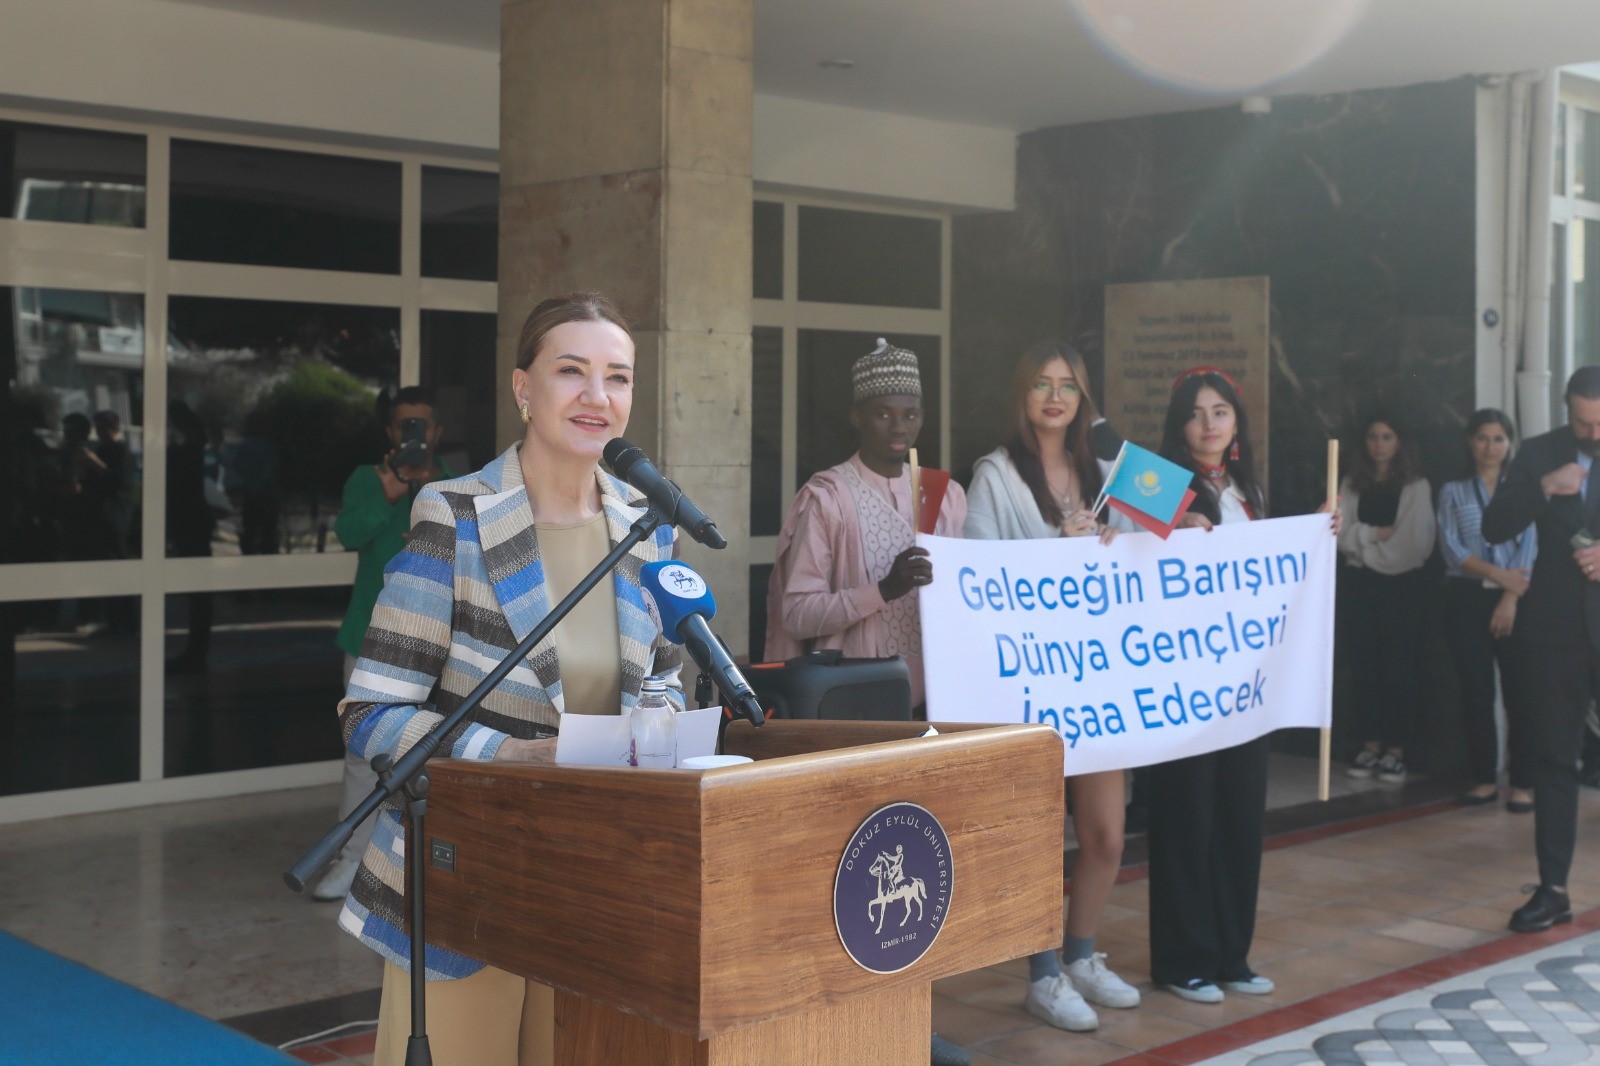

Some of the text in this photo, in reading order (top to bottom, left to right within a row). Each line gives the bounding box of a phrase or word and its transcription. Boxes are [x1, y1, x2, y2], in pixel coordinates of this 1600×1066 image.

[958, 551, 1308, 618] Geleceğin Barışını
[994, 604, 1290, 690] Dünya Gençleri
[1132, 668, 1267, 731] Edecek
[845, 822, 882, 872] DOKUZ
[886, 813, 920, 829] EYLÜL
